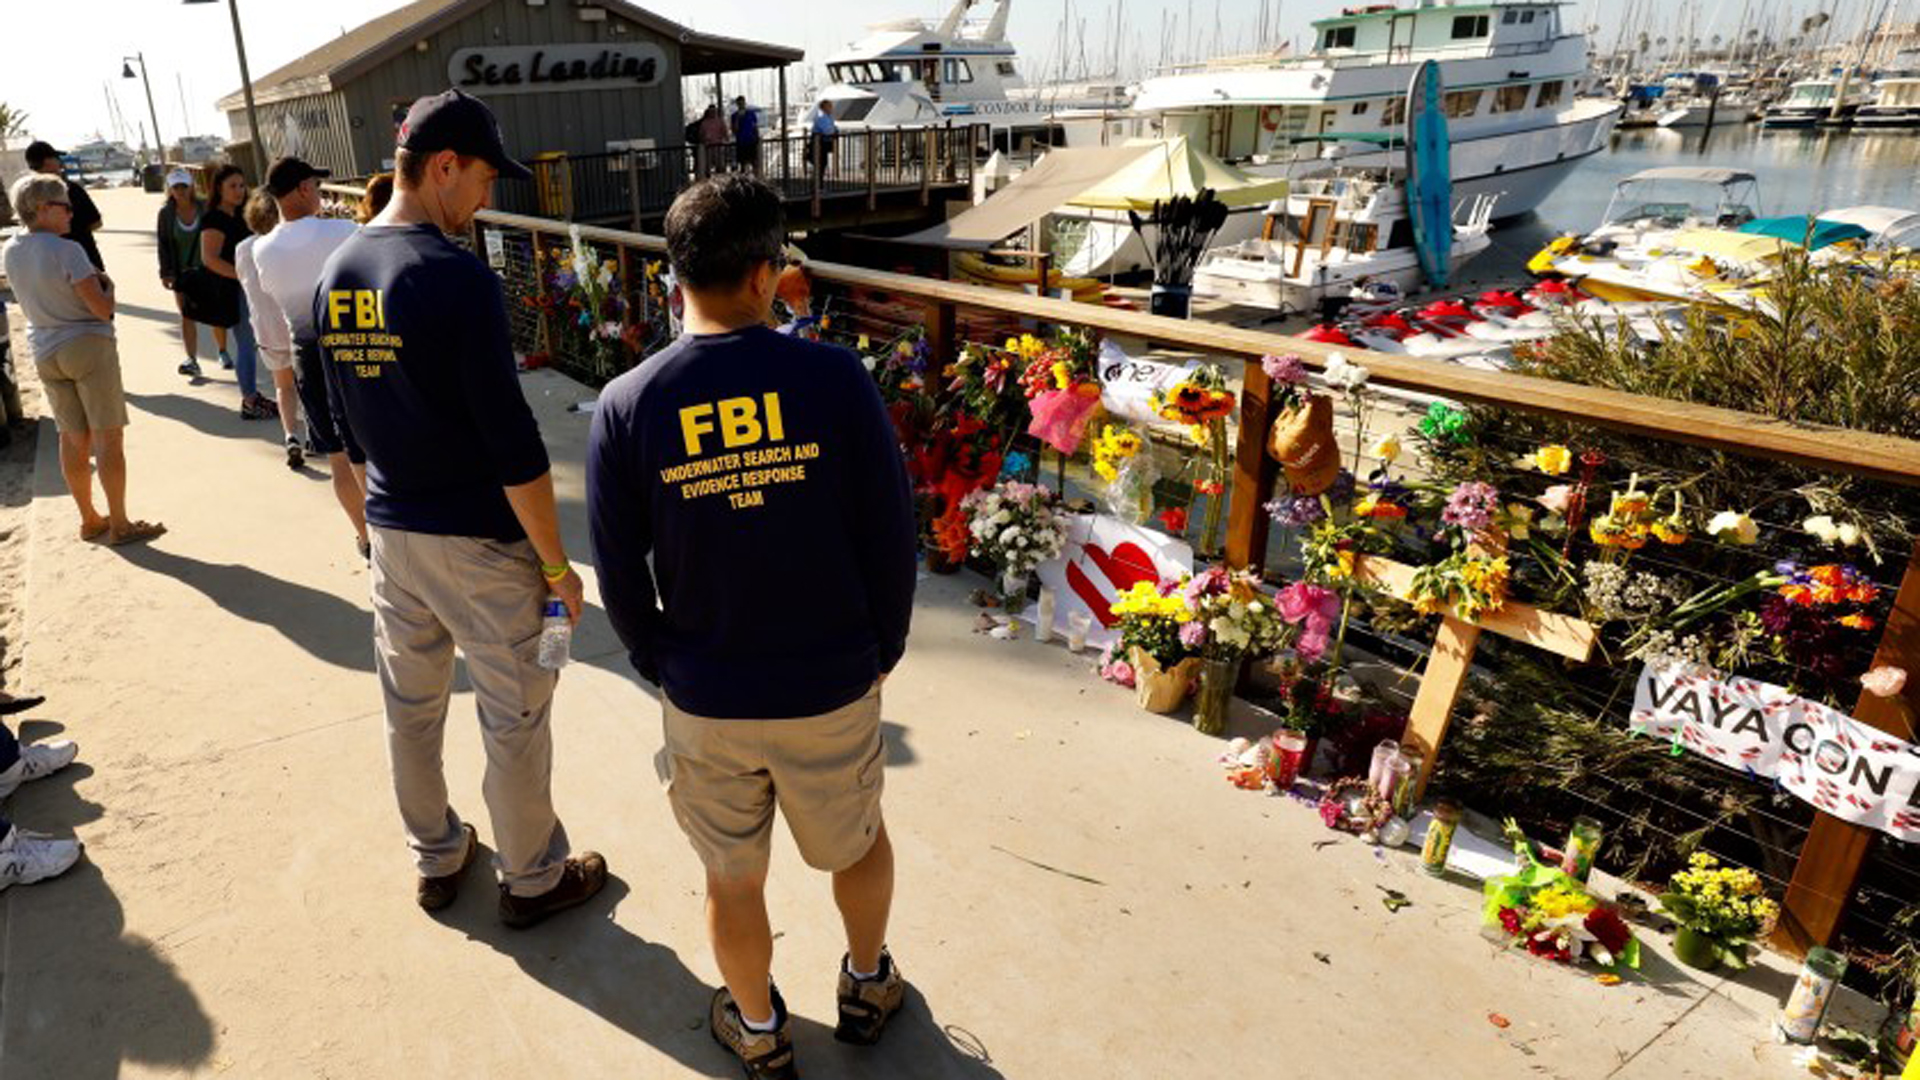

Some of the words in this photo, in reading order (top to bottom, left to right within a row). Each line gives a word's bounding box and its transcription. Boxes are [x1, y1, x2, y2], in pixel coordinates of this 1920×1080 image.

[461, 53, 523, 86] Sea
[529, 51, 657, 84] Landing
[974, 102, 1030, 115] CONDOR
[328, 288, 385, 329] FBI
[354, 363, 381, 378] TEAM
[678, 391, 785, 457] FBI
[660, 453, 742, 484] UNDERWATER
[742, 446, 792, 467] SEARCH
[794, 443, 820, 460] AND
[681, 474, 741, 500] EVIDENCE
[741, 465, 806, 487] RESPONSE
[728, 490, 765, 510] TEAM
[1648, 676, 1770, 743] VAYA
[1782, 722, 1894, 797] CON
